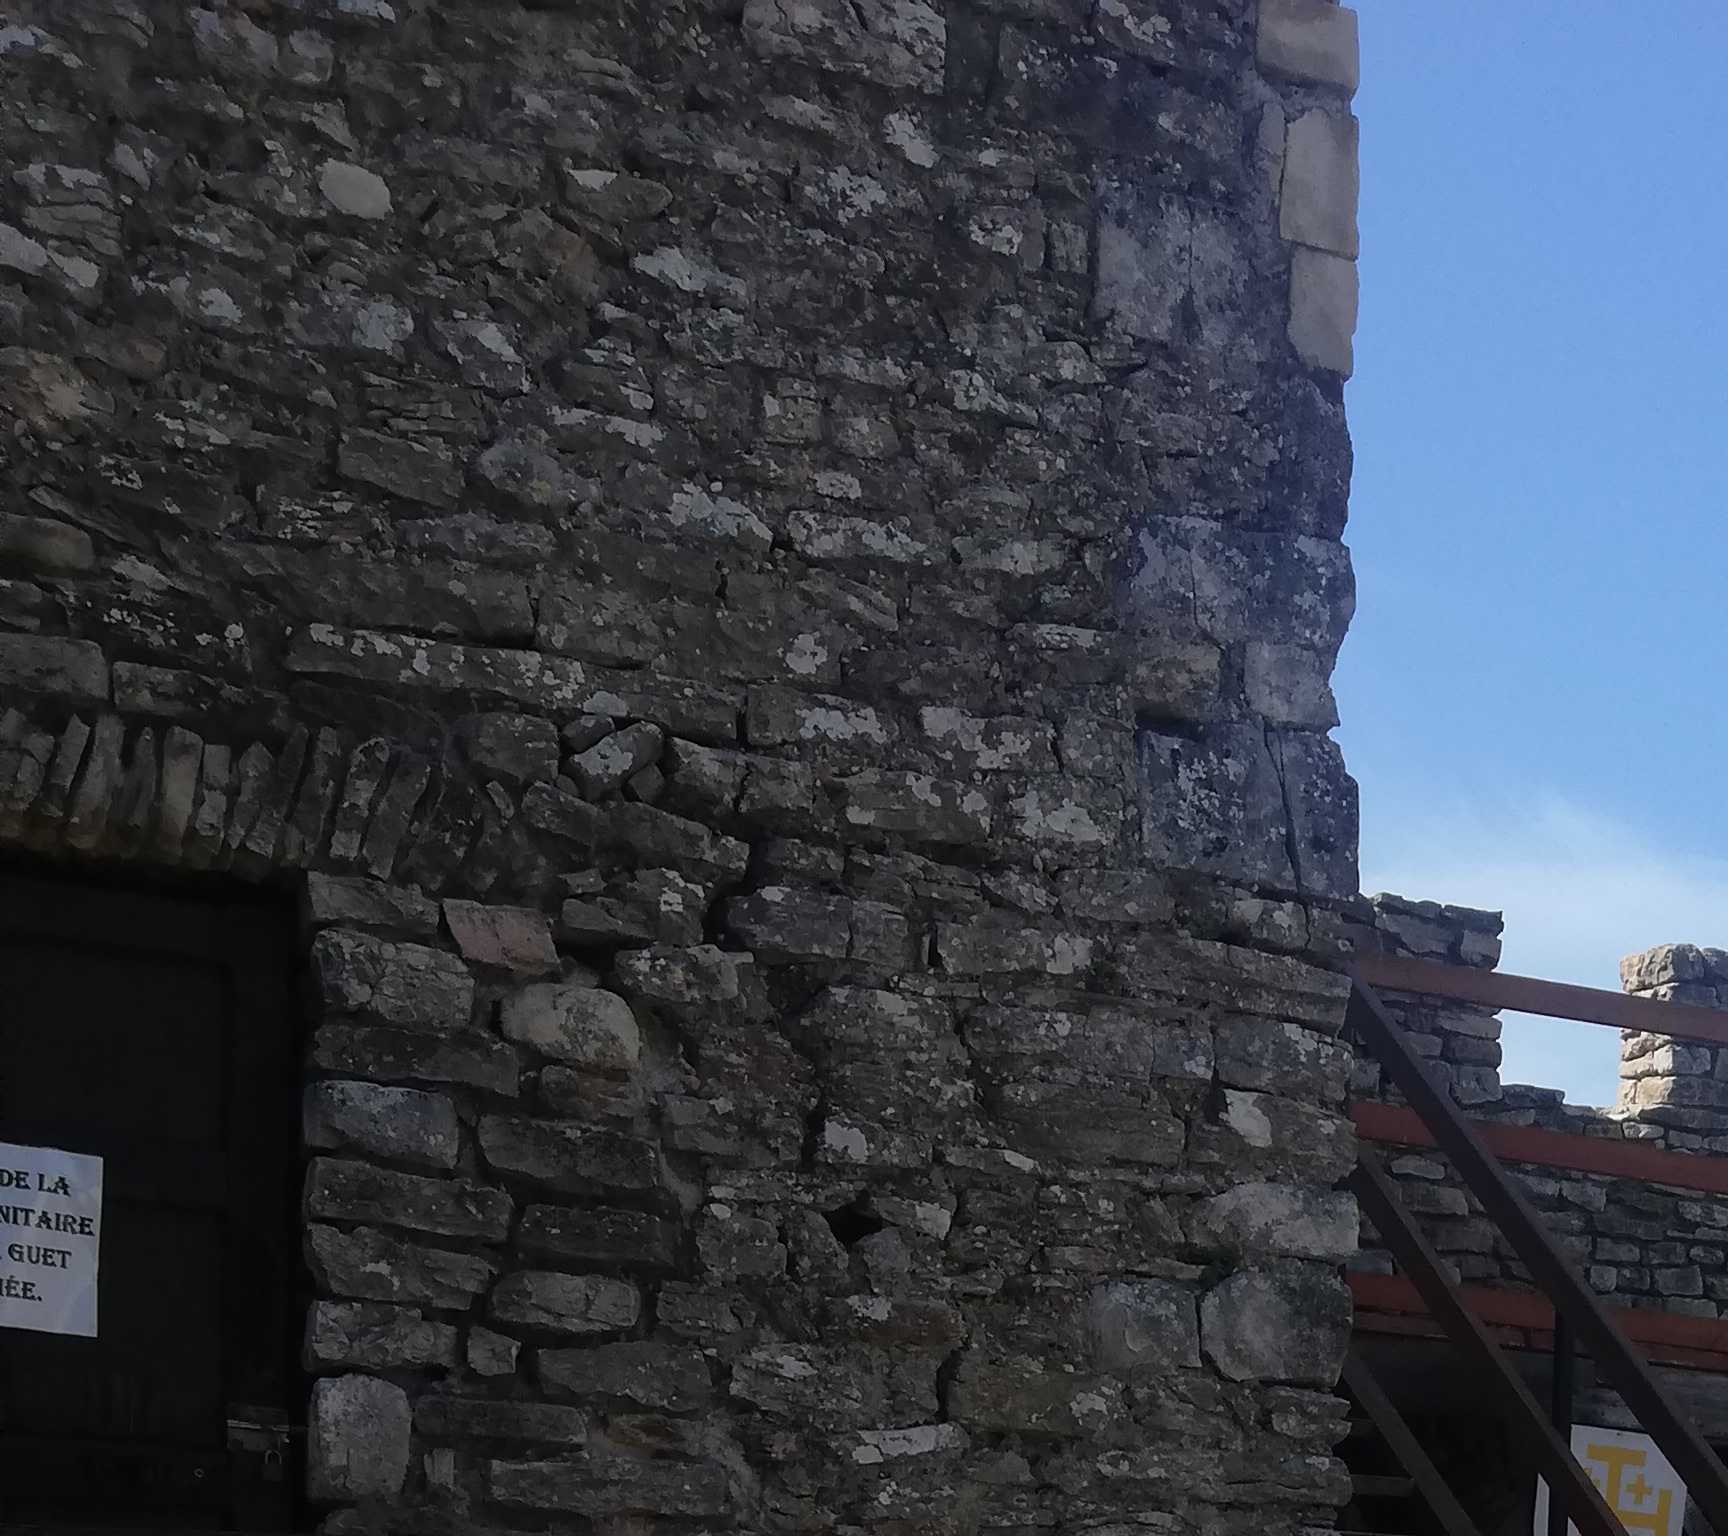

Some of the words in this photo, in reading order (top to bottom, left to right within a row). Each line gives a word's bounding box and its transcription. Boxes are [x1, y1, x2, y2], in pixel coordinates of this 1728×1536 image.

[0, 1168, 31, 1190] DE
[38, 1172, 72, 1197] LA
[7, 1243, 72, 1270] GUET
